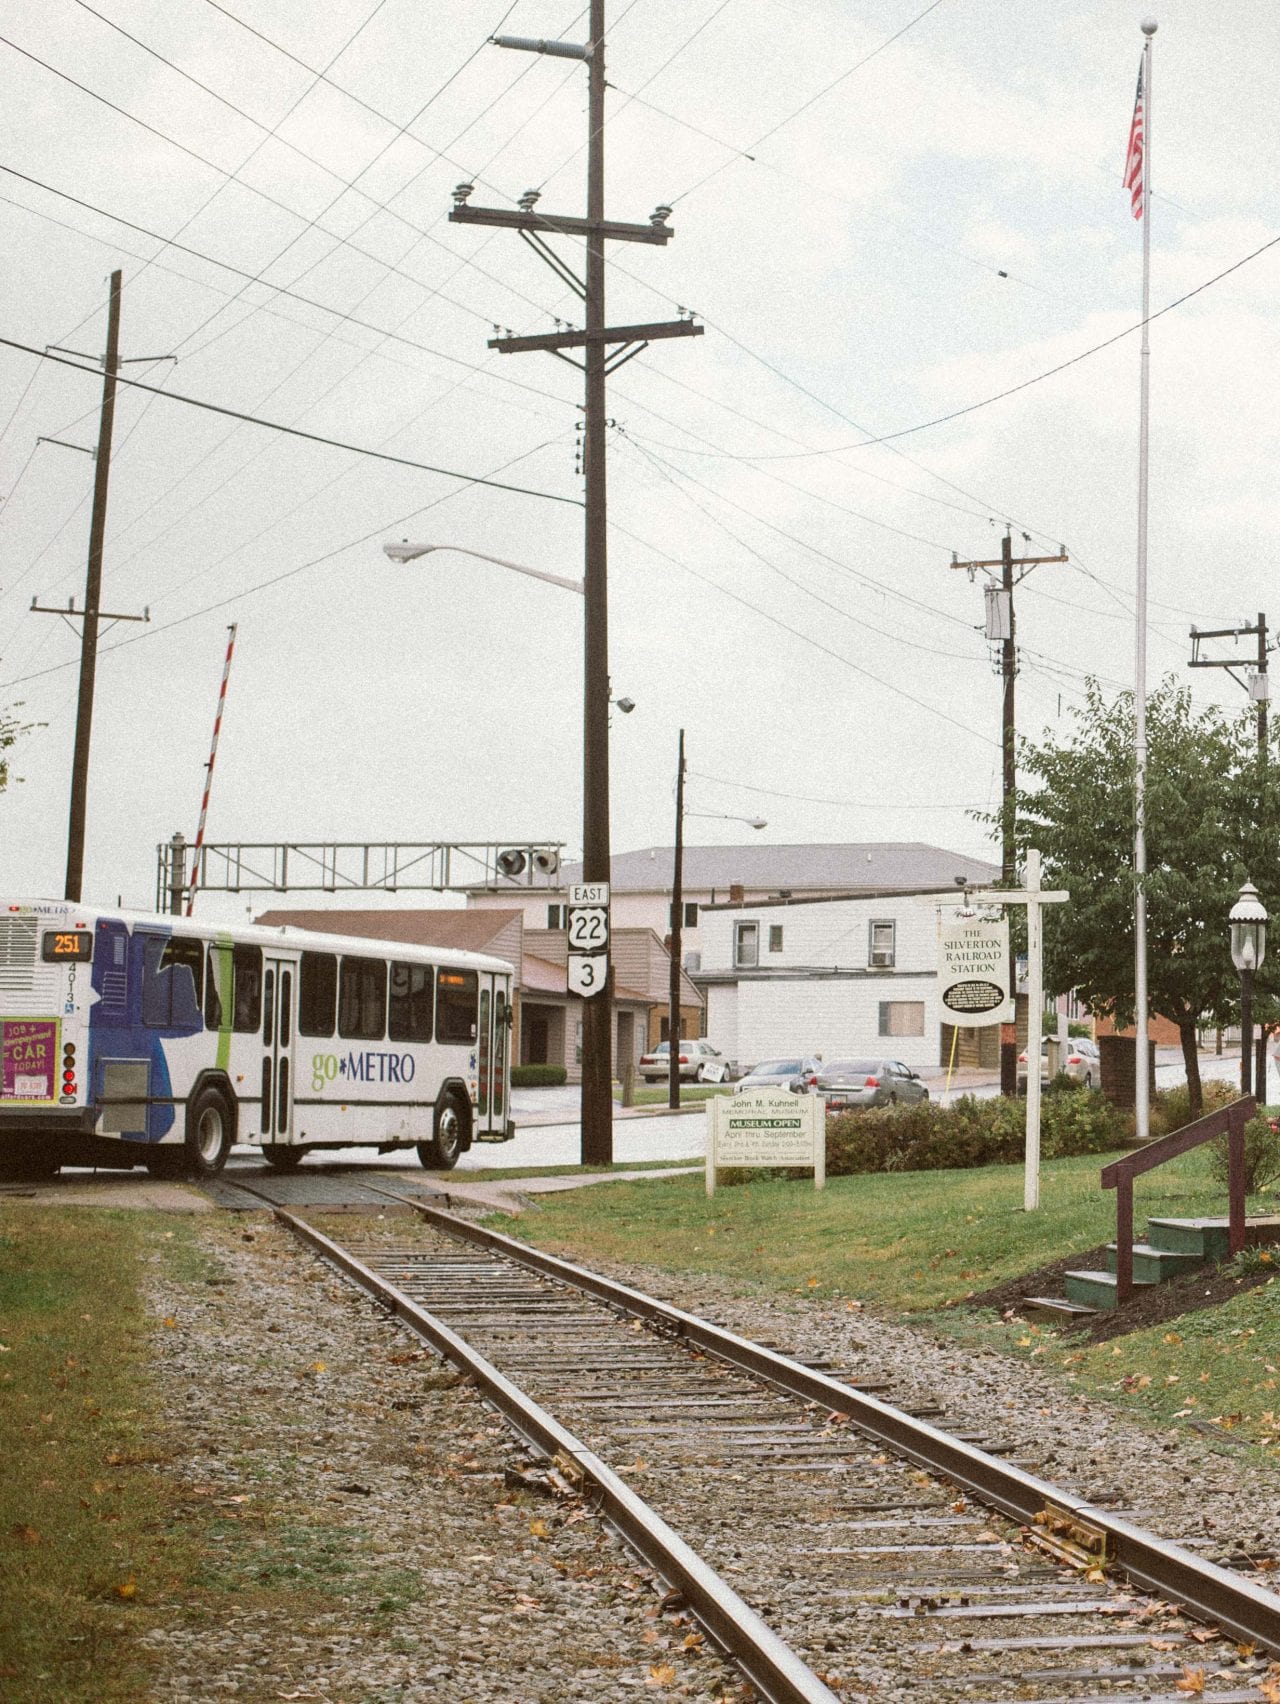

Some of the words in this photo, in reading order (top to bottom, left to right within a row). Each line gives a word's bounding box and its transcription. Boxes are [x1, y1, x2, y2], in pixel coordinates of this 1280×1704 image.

[574, 887, 602, 900] EAST
[575, 916, 601, 940] 22
[963, 930, 982, 938] THE
[54, 934, 80, 954] 251
[944, 940, 1001, 950] SILVERTON
[946, 951, 1002, 961] RAILROAD
[951, 963, 995, 973] STATION
[580, 963, 594, 987] 3
[9, 1024, 26, 1037] JOB
[13, 1044, 46, 1060] CAR
[311, 1053, 338, 1092] go
[347, 1051, 415, 1083] METRO
[731, 1100, 752, 1108] John
[768, 1099, 799, 1107] Kuhnell
[730, 1120, 771, 1128] MUSEUM
[773, 1119, 800, 1127] OPEN
[724, 1130, 742, 1139] April
[745, 1130, 760, 1138] thru
[764, 1130, 807, 1139] September
